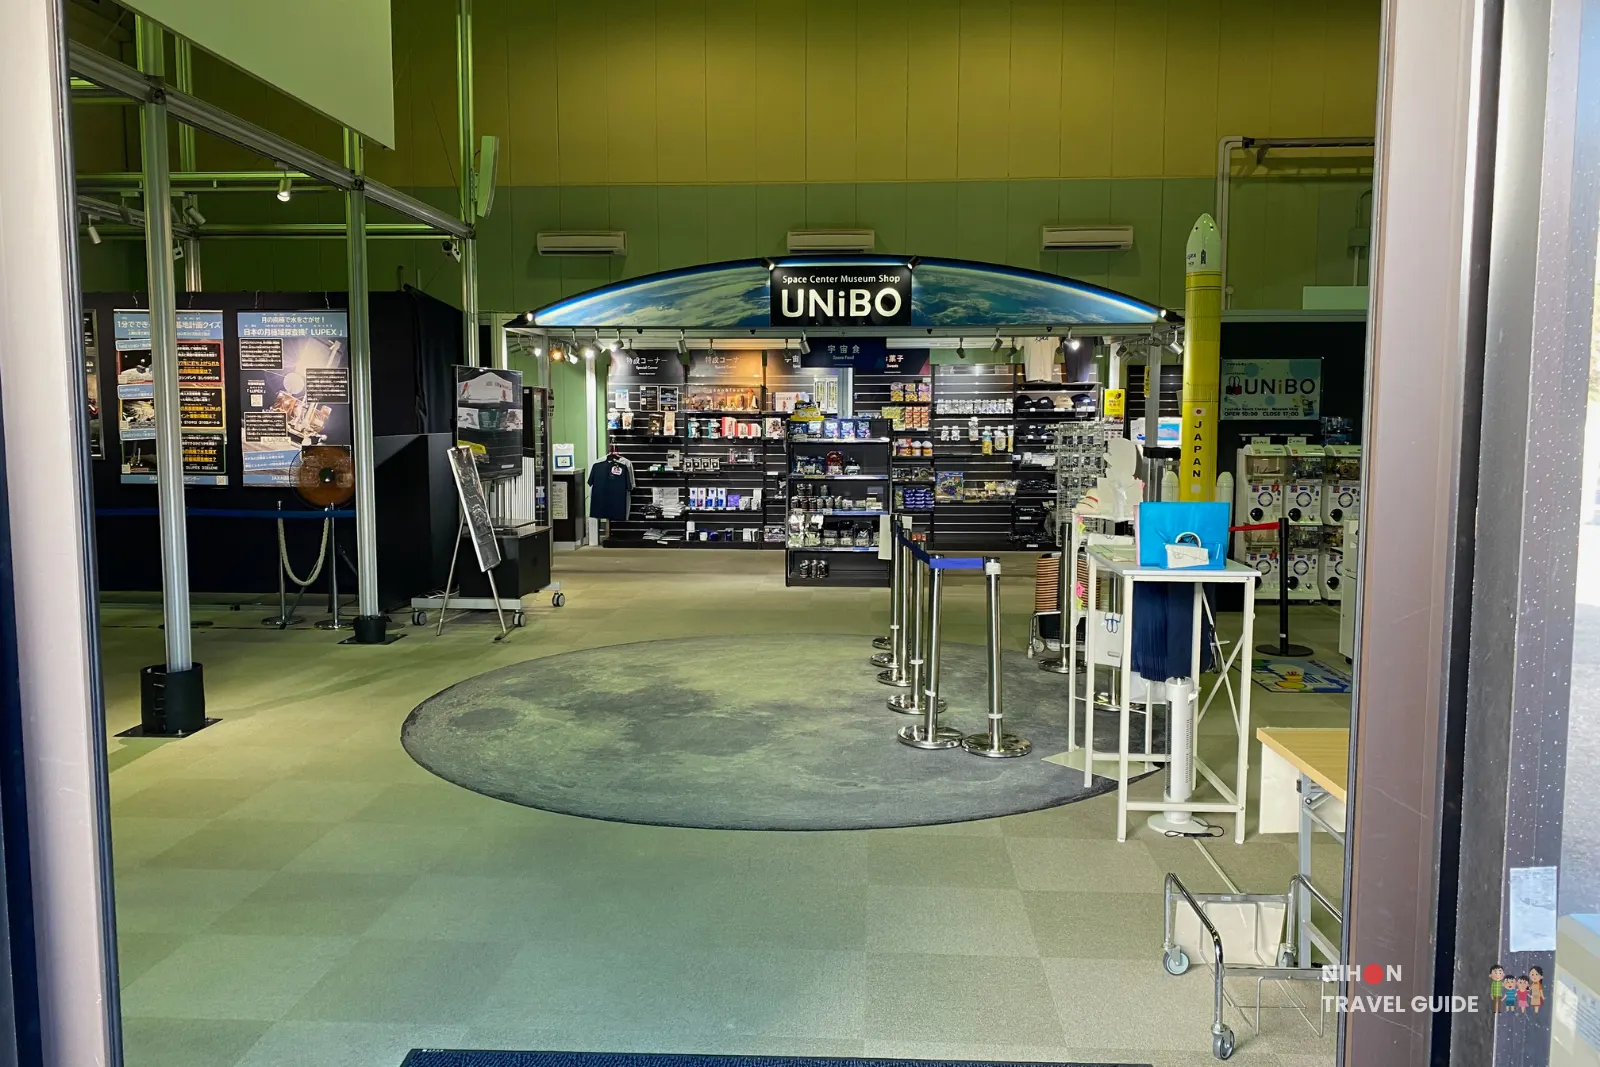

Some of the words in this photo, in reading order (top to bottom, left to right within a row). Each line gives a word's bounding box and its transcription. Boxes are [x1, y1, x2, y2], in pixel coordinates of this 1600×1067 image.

[782, 275, 808, 285] Space
[809, 275, 839, 284] Center
[840, 274, 876, 284] Museum
[878, 274, 901, 284] Shop
[781, 287, 902, 318] UNiBO
[117, 321, 150, 329] 1分ででき
[827, 344, 860, 354] 宇宙食
[626, 356, 668, 365] 特設コーナー
[1244, 378, 1316, 395] UNiBO
[1192, 420, 1202, 478] JAPAN
